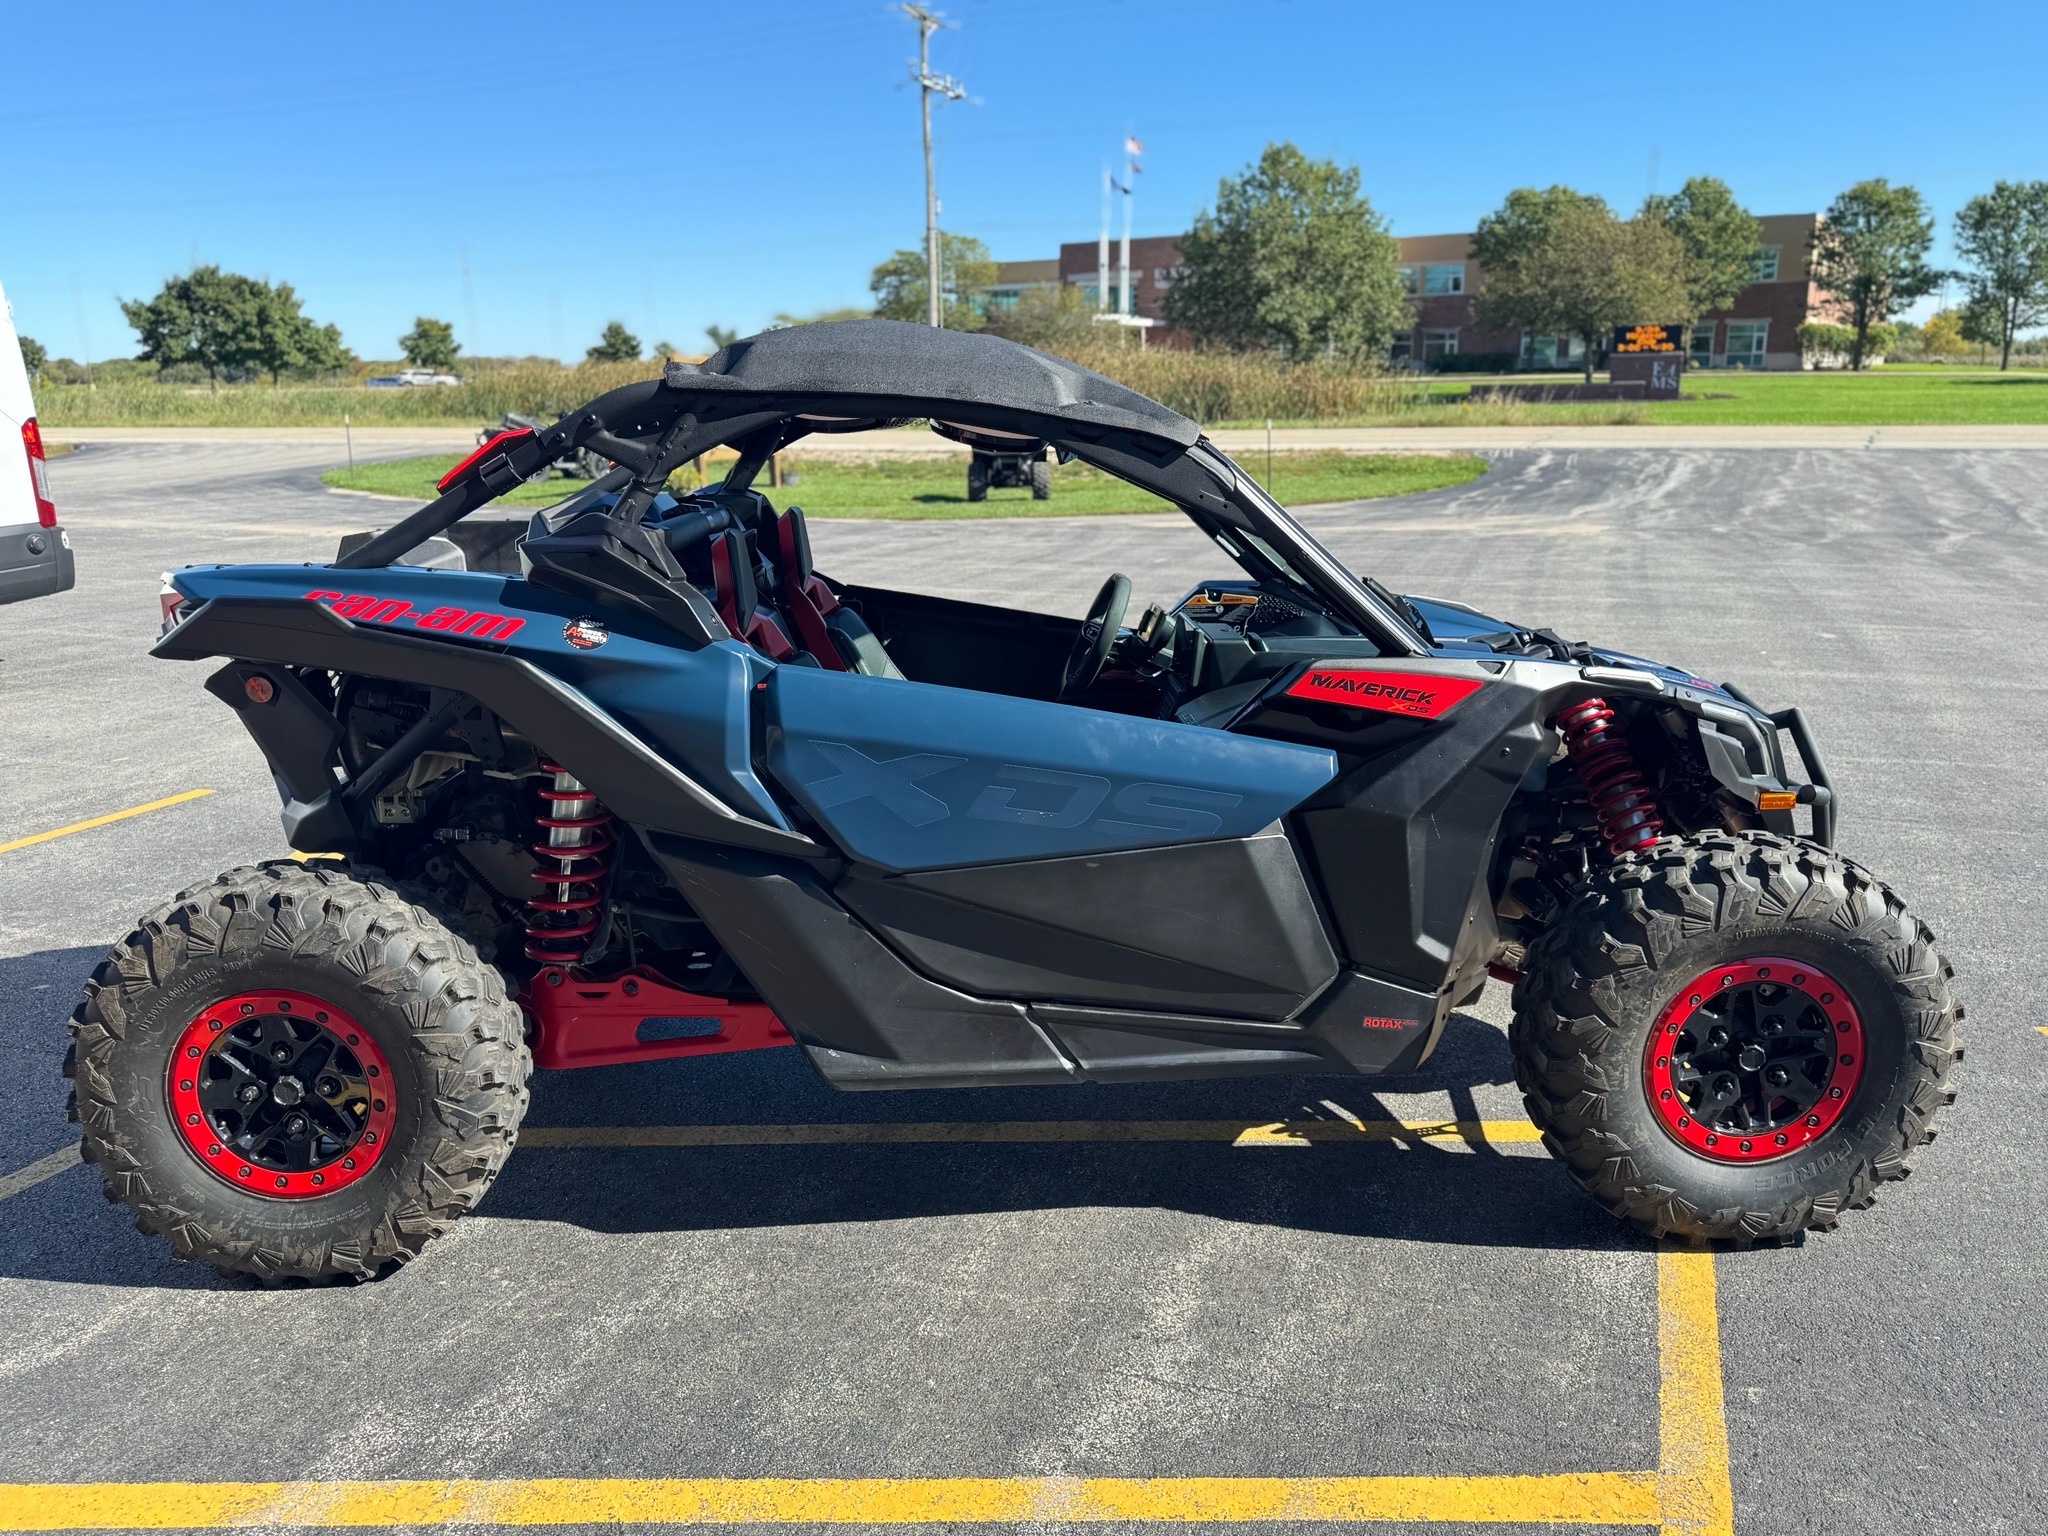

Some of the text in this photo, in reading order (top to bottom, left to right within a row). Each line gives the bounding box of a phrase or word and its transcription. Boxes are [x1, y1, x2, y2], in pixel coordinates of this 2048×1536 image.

[566, 626, 583, 637] A+
[1310, 673, 1438, 706] MAVERICK
[1387, 701, 1431, 714] XDS
[804, 739, 1244, 838] XDS
[1363, 1016, 1402, 1029] ROTAX
[1754, 1138, 1853, 1192] FORCE
